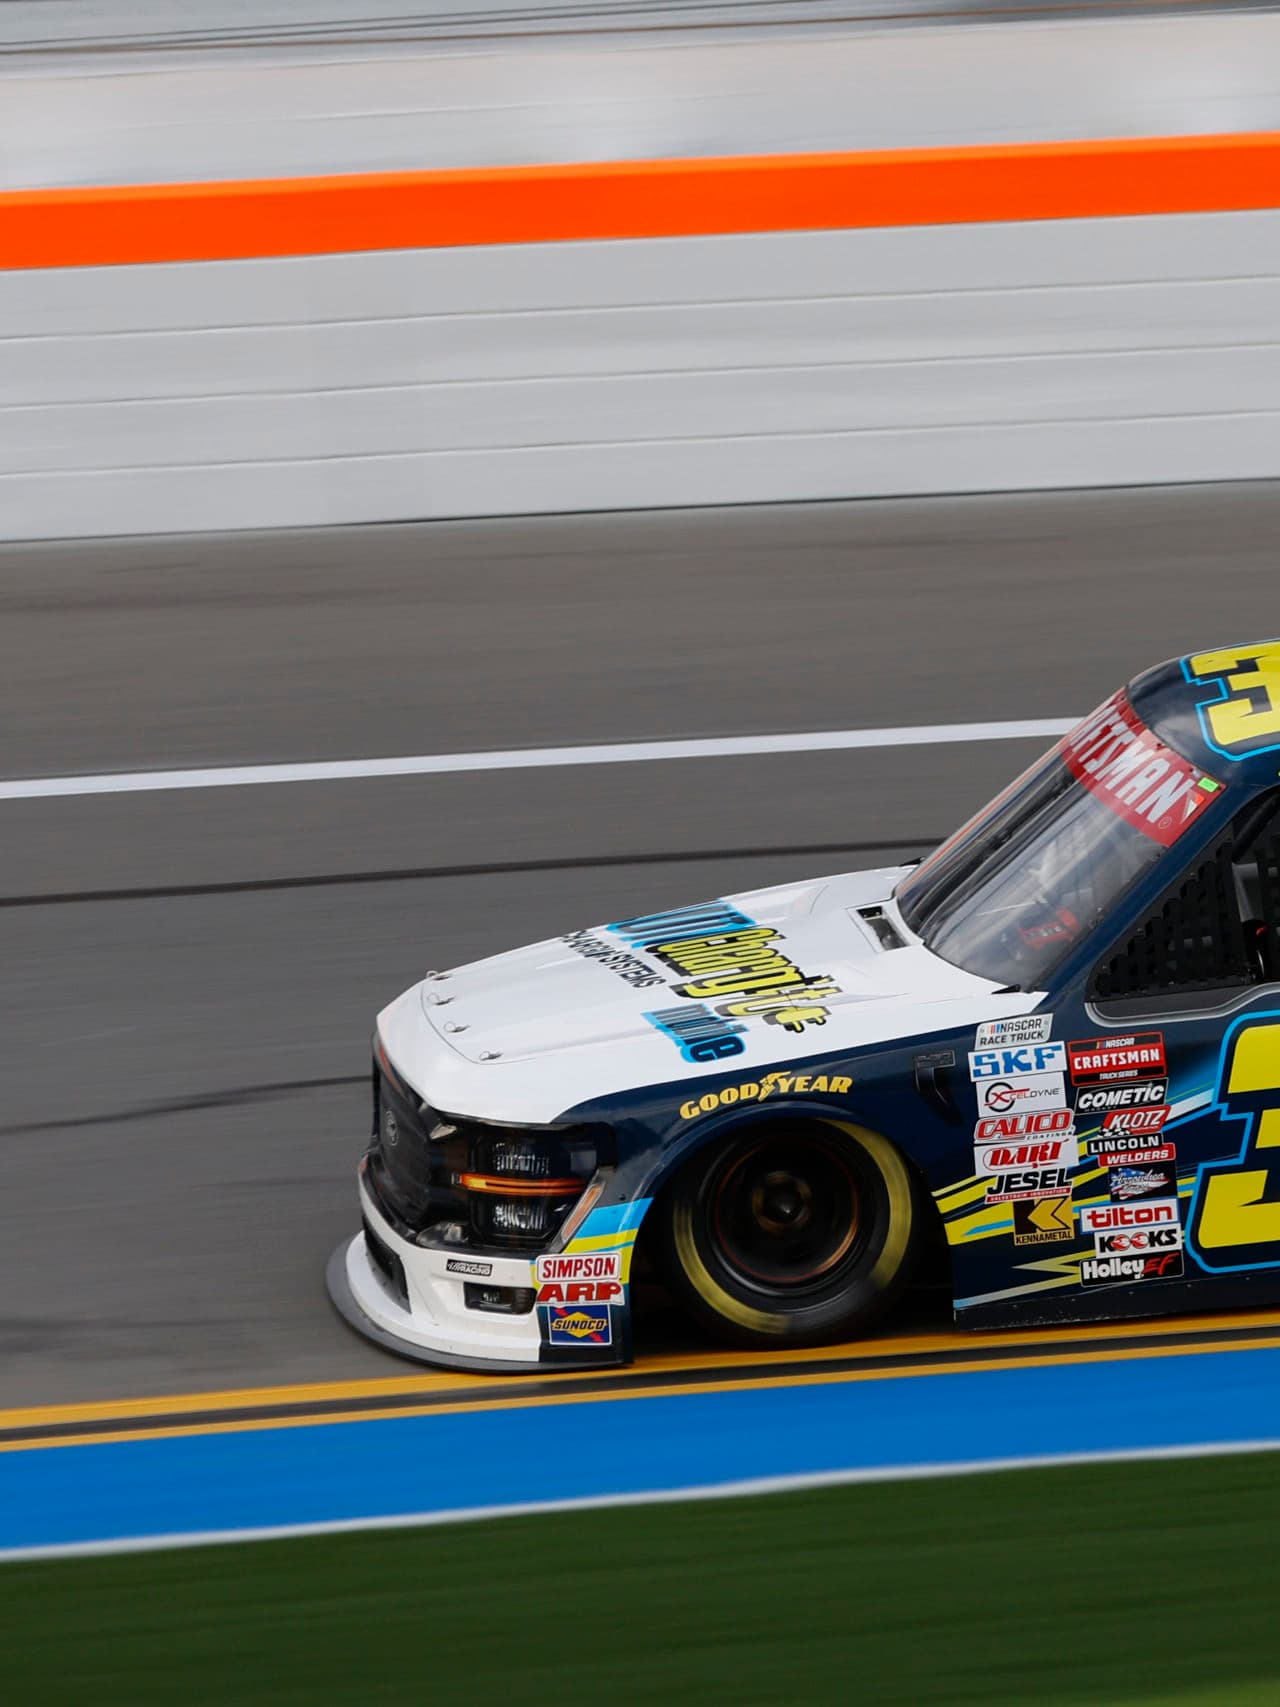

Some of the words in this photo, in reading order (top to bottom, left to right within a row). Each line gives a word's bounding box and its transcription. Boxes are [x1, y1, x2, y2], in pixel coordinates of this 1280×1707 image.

[600, 950, 667, 989] SYSTEMS
[1000, 1018, 1042, 1033] NASCAR
[980, 1035, 1007, 1046] RACE
[1011, 1030, 1044, 1042] TRUCK
[1105, 1037, 1135, 1049] NASCAR
[973, 1045, 1062, 1078] SKF
[1073, 1048, 1160, 1070] CRAFTSMAN
[680, 1073, 854, 1121] GOODYEAR
[1078, 1085, 1165, 1109] COMETIC
[978, 1111, 1071, 1139] CALICO
[1109, 1110, 1166, 1130] KLOTZ
[1090, 1135, 1159, 1154] LINCOLN
[1107, 1149, 1169, 1165] WELDERS
[987, 1168, 1072, 1195] JESEL
[1087, 1206, 1173, 1228] tilton
[1016, 1231, 1072, 1244] KENNAMETAL
[1099, 1228, 1178, 1253] KOOKS
[542, 1256, 616, 1279] SIMPSON
[1083, 1257, 1145, 1280] Holley
[536, 1281, 623, 1303] ARP
[554, 1318, 606, 1331] SUNOCO
